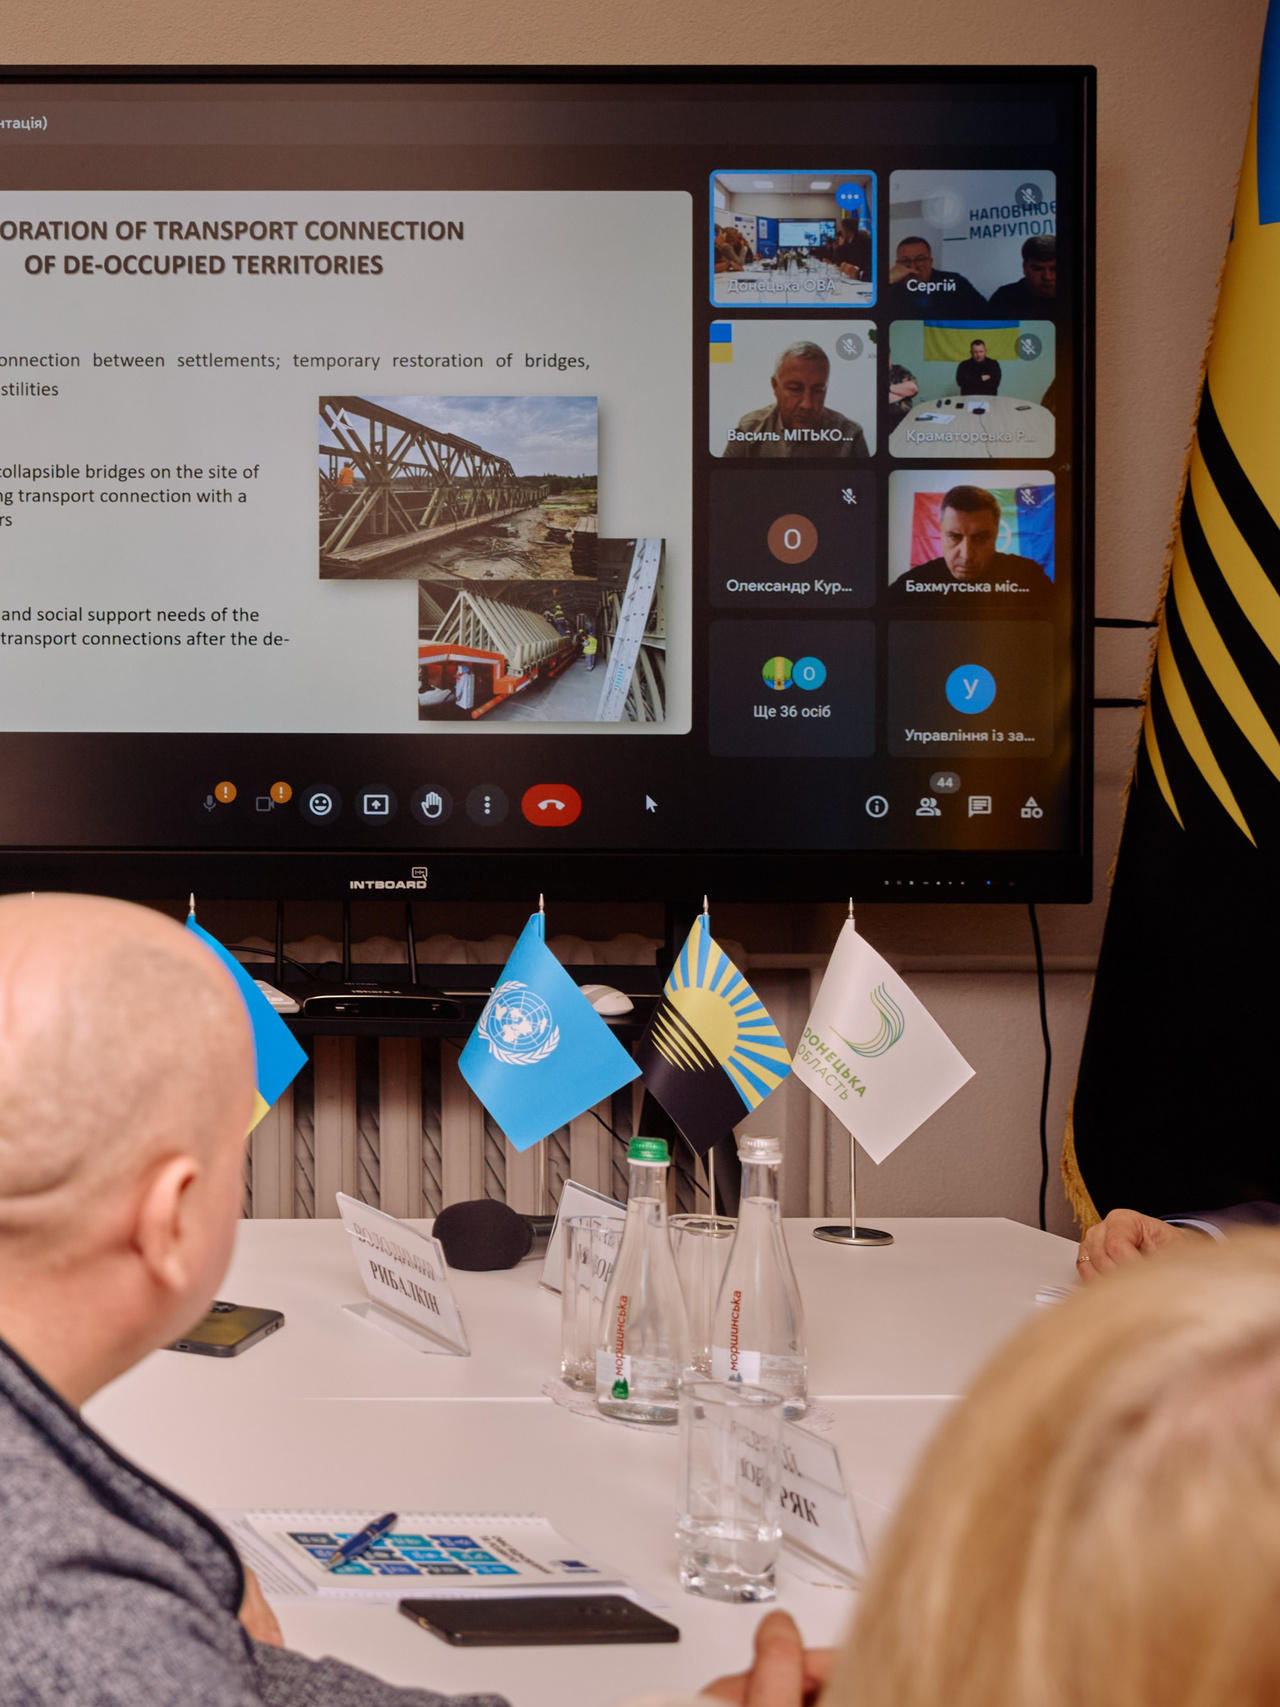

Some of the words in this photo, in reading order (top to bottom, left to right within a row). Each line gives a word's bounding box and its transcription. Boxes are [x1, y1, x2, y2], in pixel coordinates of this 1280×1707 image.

[115, 220, 148, 241] OF
[153, 220, 299, 241] TRANSPORT
[304, 220, 465, 242] CONNECTION
[24, 254, 57, 276] OF
[63, 254, 226, 276] DE-OCCUPIED
[231, 254, 384, 276] TERRITORIES
[727, 279, 800, 294] Донецька
[803, 279, 837, 292] ОВА
[906, 278, 957, 295] Сергій
[93, 352, 165, 368] between
[177, 352, 280, 371] settlements;
[292, 354, 381, 371] temporary
[392, 353, 484, 368] restoration
[495, 352, 514, 368] of
[524, 352, 590, 372] bridges,
[726, 428, 781, 443] Василь
[783, 428, 854, 443] МІТЬКО...
[905, 429, 1013, 445] Краматорська
[85, 463, 146, 483] bridges
[150, 467, 171, 479] on
[175, 463, 204, 479] the
[208, 464, 238, 479] site
[242, 463, 260, 479] of
[17, 489, 95, 507] transport
[99, 488, 192, 503] connection
[196, 488, 233, 503] with
[237, 492, 247, 503] a
[726, 578, 811, 595] Олександр
[814, 579, 853, 595] Кур...
[905, 579, 992, 596] Бахмутська
[994, 579, 1030, 593] міс...
[1, 606, 32, 622] and
[36, 606, 83, 622] social
[87, 608, 152, 625] support
[157, 606, 206, 622] needs
[210, 606, 229, 622] of
[231, 607, 260, 622] the
[0, 631, 77, 649] transport
[81, 631, 182, 646] connections
[186, 630, 226, 646] after
[230, 631, 258, 646] the
[262, 631, 290, 646] de-
[753, 704, 777, 720] Ще
[779, 704, 798, 718] 36
[801, 704, 832, 718] осіб
[904, 728, 989, 745] Управління
[991, 728, 1005, 742] із
[1007, 731, 1036, 742] за...
[936, 775, 954, 789] 44
[349, 880, 428, 890] INTBOARD
[796, 1043, 849, 1101] ОБЛАСТЬ
[368, 1259, 441, 1316] РИБАЛКІН
[614, 1294, 629, 1377] моршинська
[729, 1289, 742, 1372] моршинська
